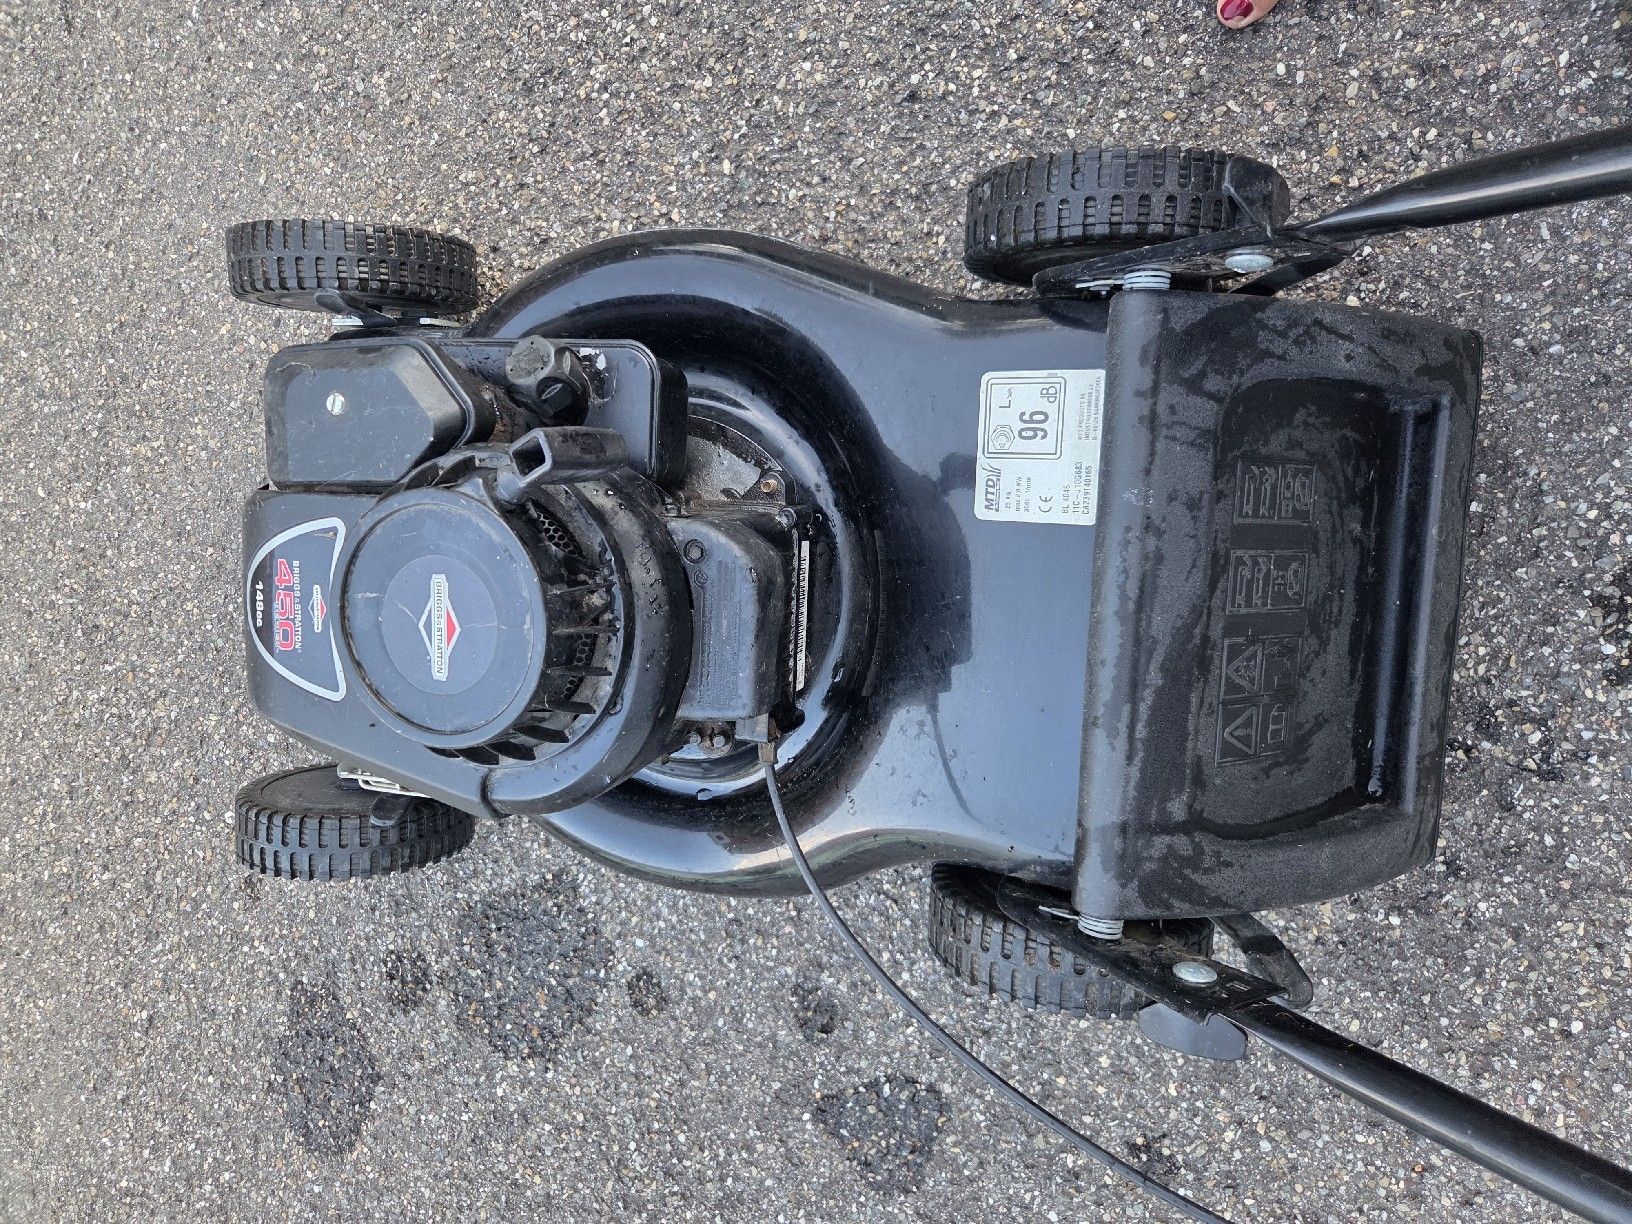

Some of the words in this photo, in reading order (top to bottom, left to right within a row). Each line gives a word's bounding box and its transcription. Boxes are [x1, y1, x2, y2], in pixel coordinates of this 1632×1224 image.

[1040, 385, 1058, 404] dB
[1018, 410, 1049, 441] 96
[984, 478, 996, 512] MTD
[255, 580, 264, 627] 148cc
[274, 559, 294, 650] 450
